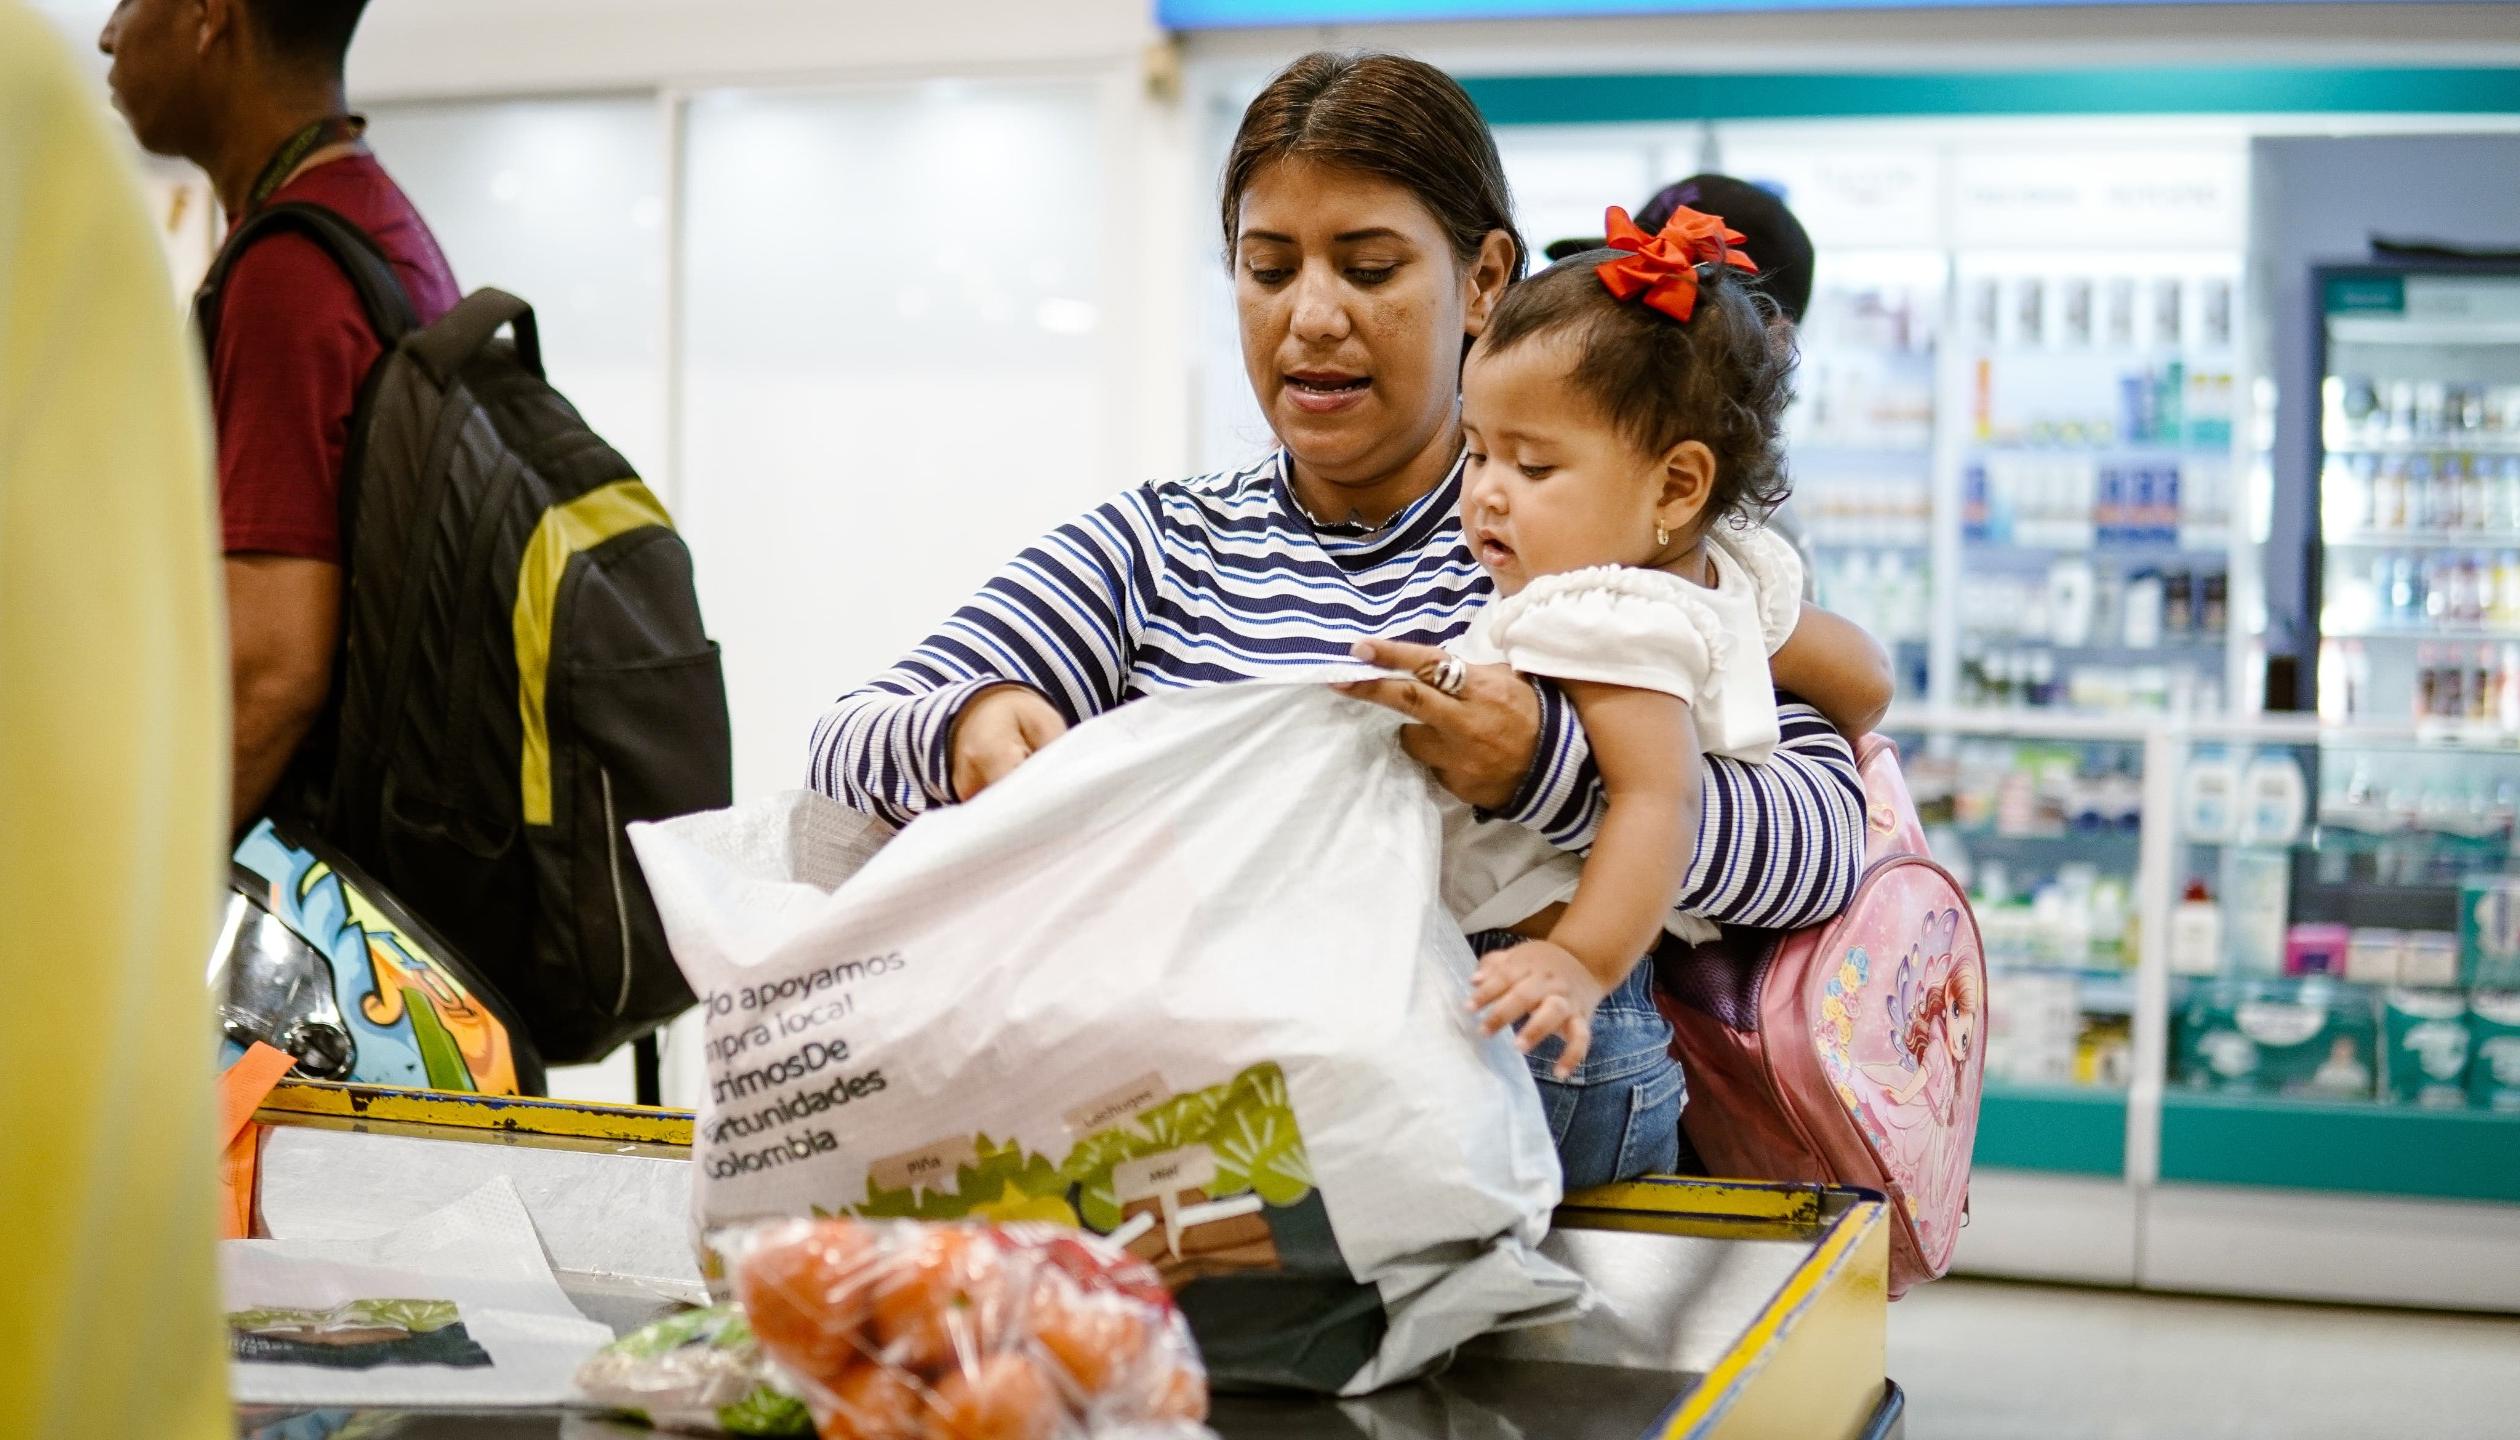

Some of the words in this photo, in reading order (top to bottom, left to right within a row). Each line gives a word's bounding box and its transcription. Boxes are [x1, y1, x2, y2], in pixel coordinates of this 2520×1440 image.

[740, 952, 905, 1012] apoyamos
[777, 994, 854, 1036] local
[704, 1128, 838, 1179] Colombia
